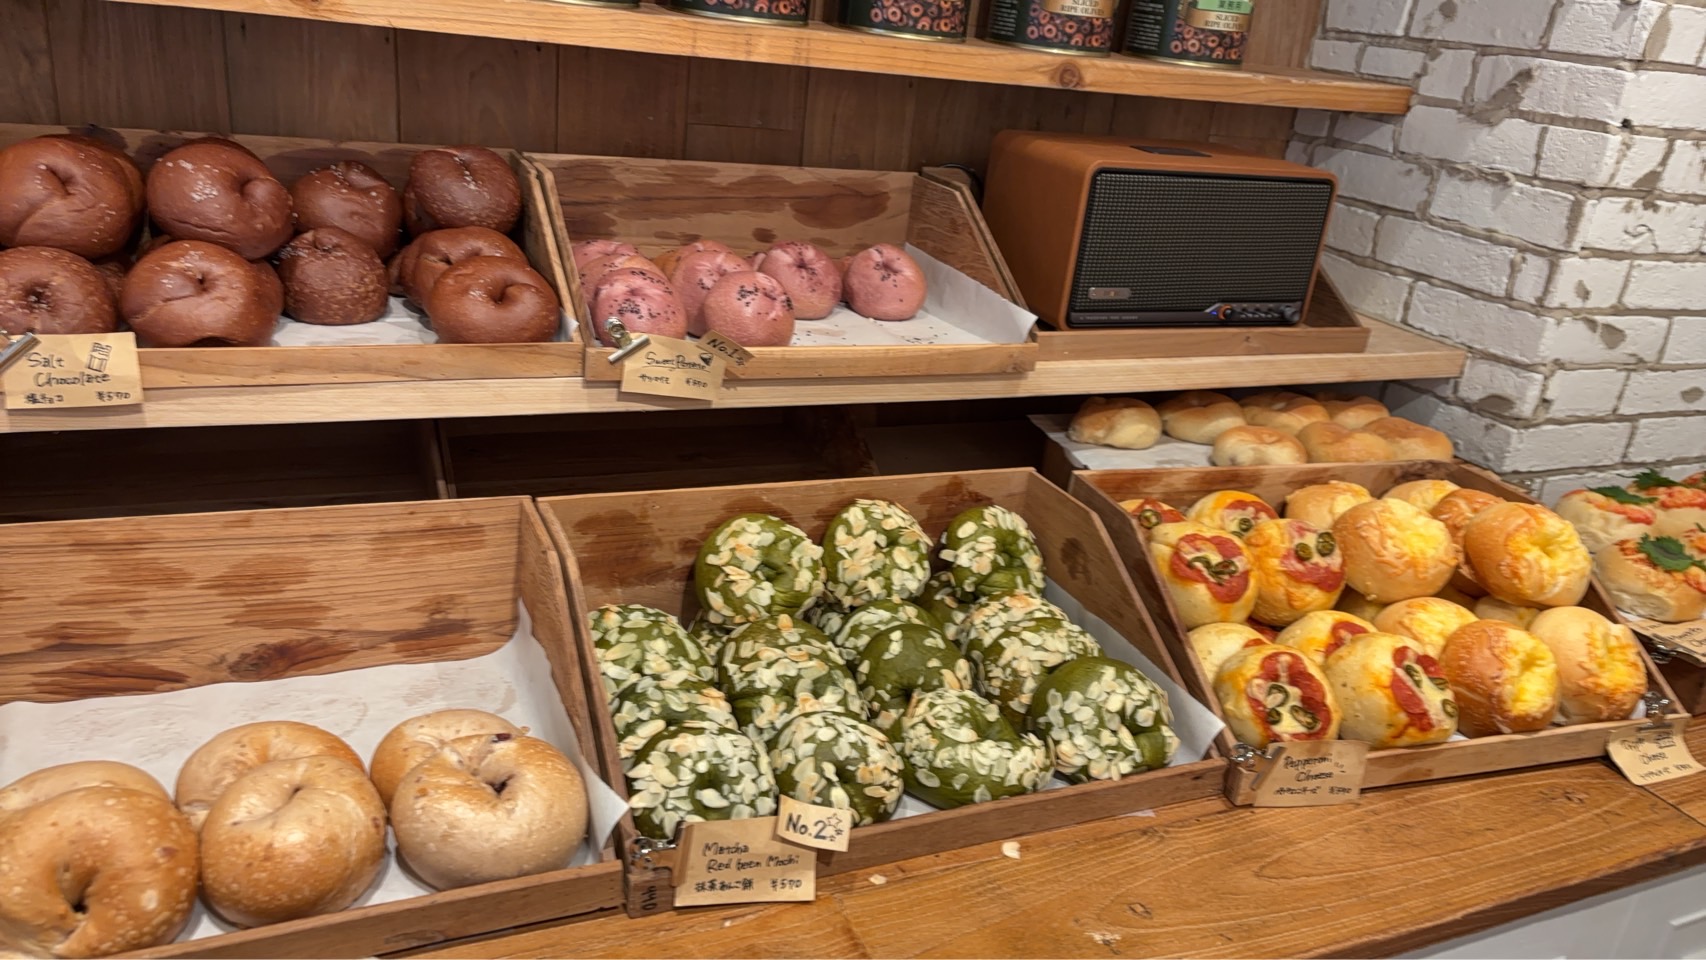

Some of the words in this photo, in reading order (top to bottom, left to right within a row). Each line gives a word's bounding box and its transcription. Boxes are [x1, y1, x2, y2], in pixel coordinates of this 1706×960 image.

[27, 351, 65, 369] Salt
[34, 371, 112, 388] Chocolate
[785, 812, 828, 840] No.2
[702, 842, 750, 857] Matcha
[706, 858, 733, 873] Red
[769, 878, 803, 892] ¥570
